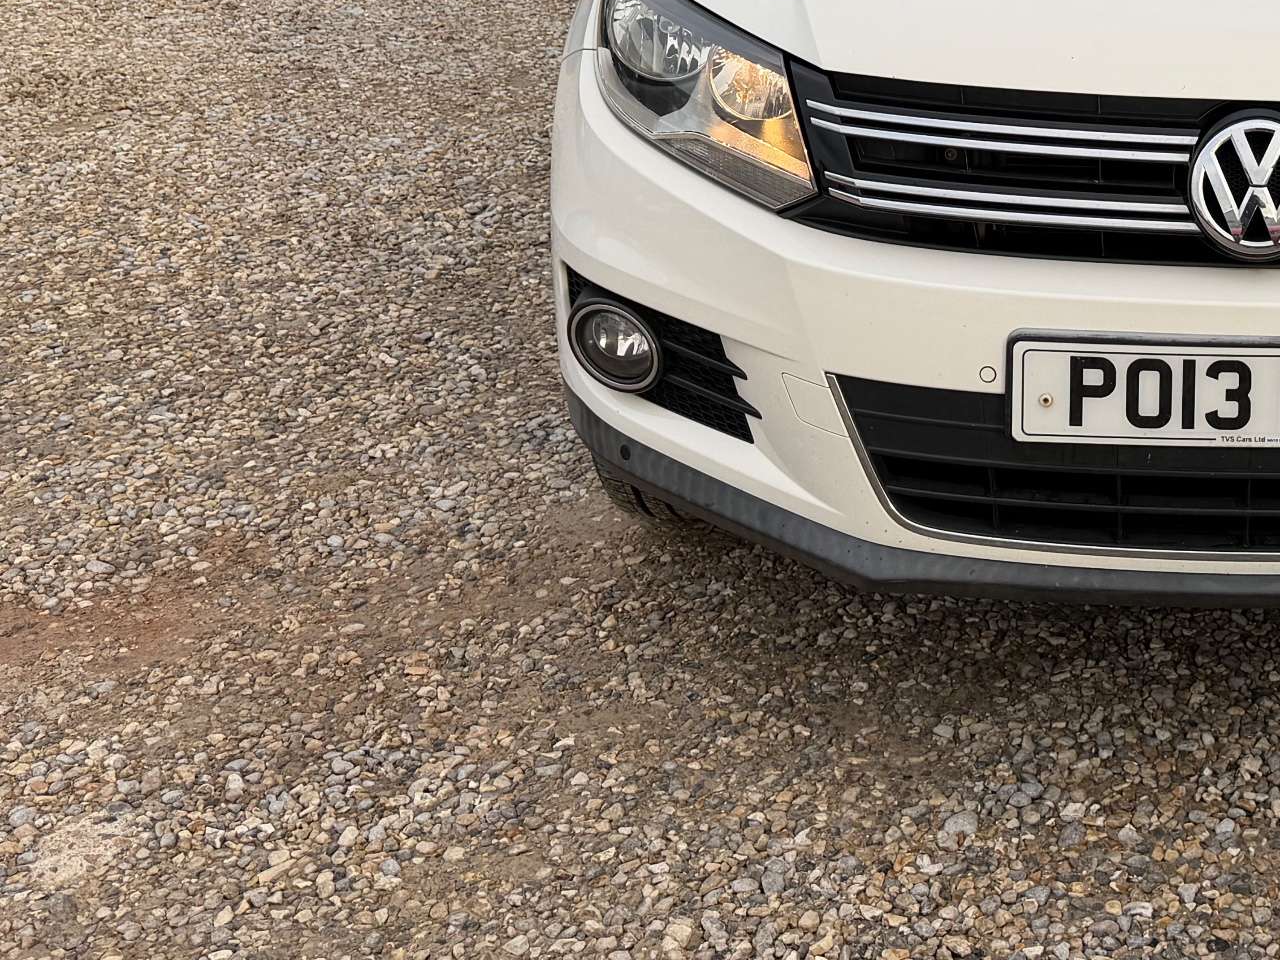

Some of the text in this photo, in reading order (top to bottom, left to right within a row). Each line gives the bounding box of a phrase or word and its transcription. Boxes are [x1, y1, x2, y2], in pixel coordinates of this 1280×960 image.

[1068, 355, 1253, 431] PO13
[1220, 435, 1235, 443] TVS
[1236, 435, 1252, 443] Cars
